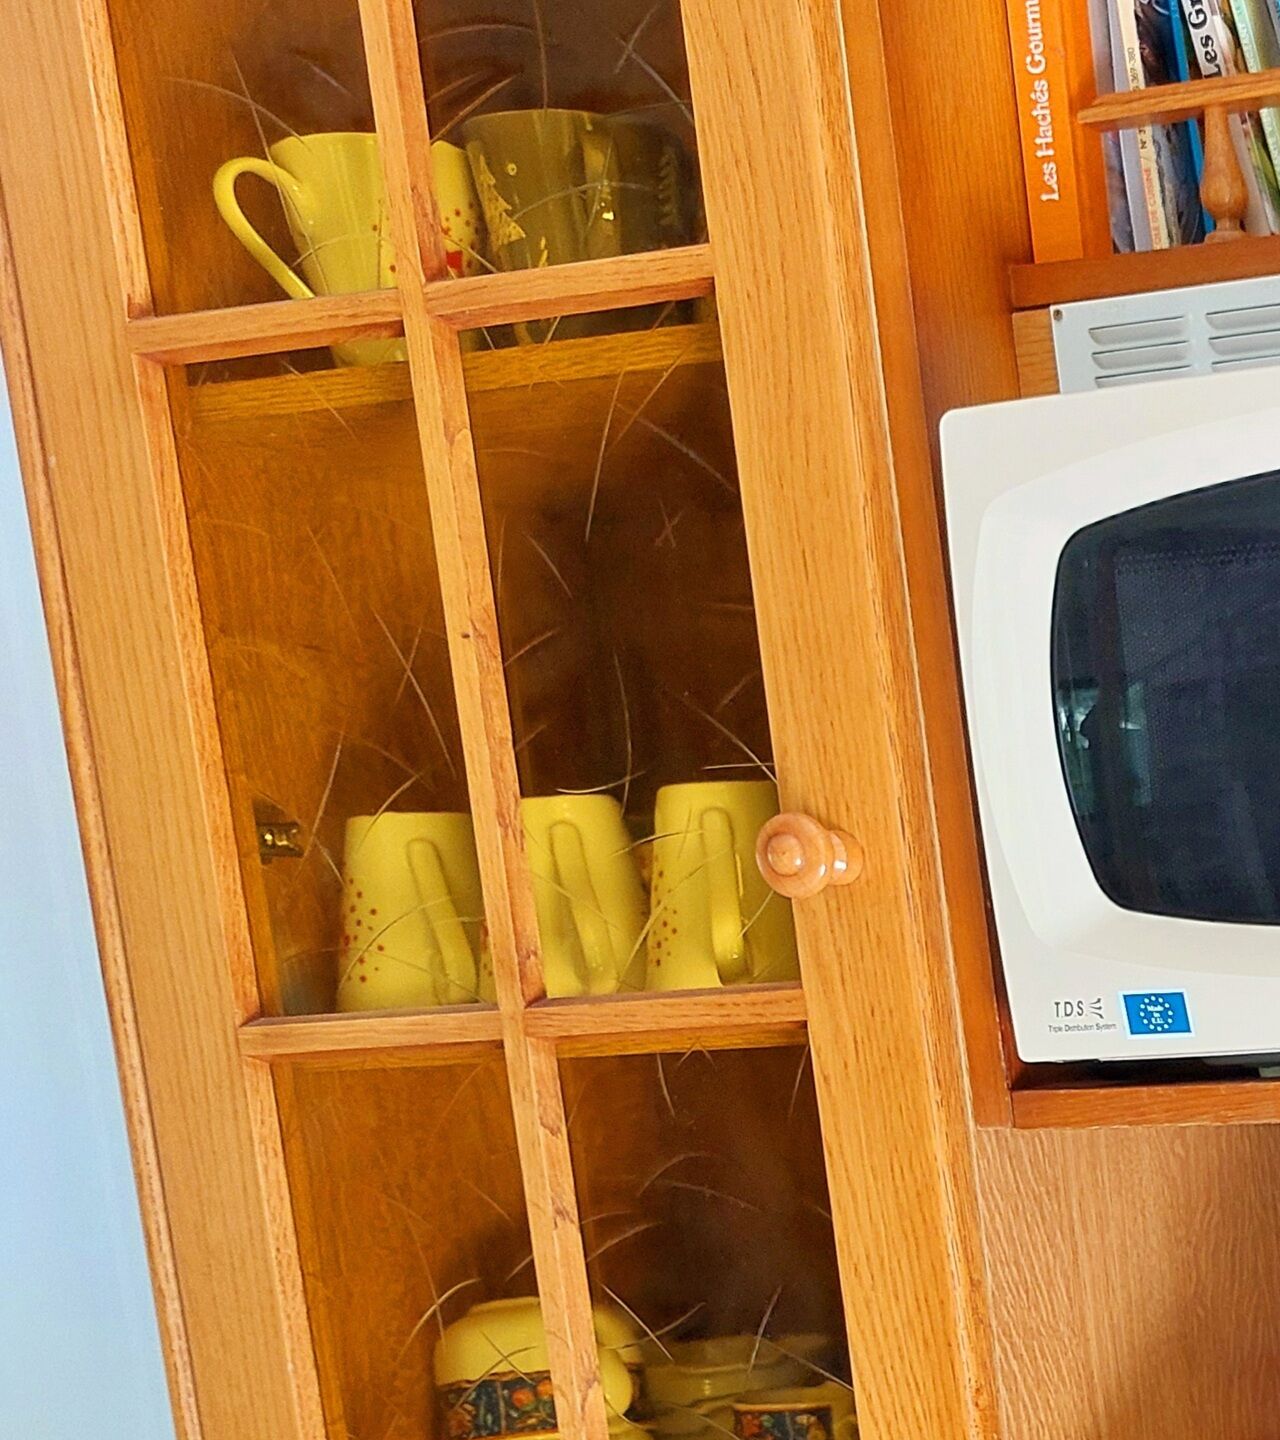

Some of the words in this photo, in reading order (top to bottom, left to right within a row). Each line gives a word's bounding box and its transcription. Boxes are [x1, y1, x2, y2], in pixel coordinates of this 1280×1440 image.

[1025, 0, 1046, 74] Gourm
[1201, 35, 1222, 78] Les
[1030, 79, 1055, 158] Hachés
[1040, 161, 1059, 202] Les
[1143, 168, 1156, 206] CUISINE
[1095, 1022, 1117, 1032] System
